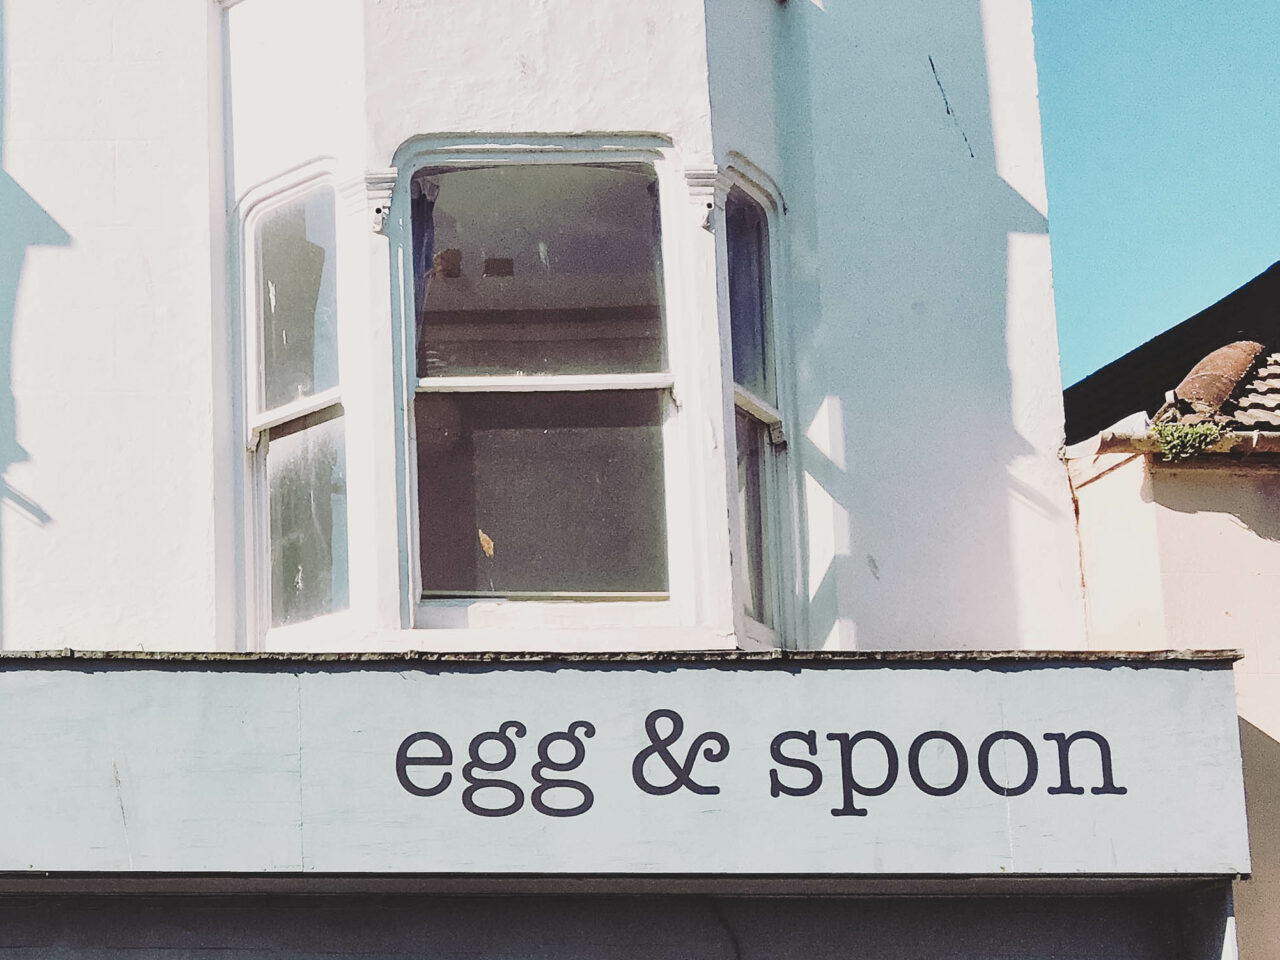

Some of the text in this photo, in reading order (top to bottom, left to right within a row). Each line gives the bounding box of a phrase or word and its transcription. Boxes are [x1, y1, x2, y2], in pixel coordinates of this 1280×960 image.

[395, 708, 1128, 817] egg & spoon
